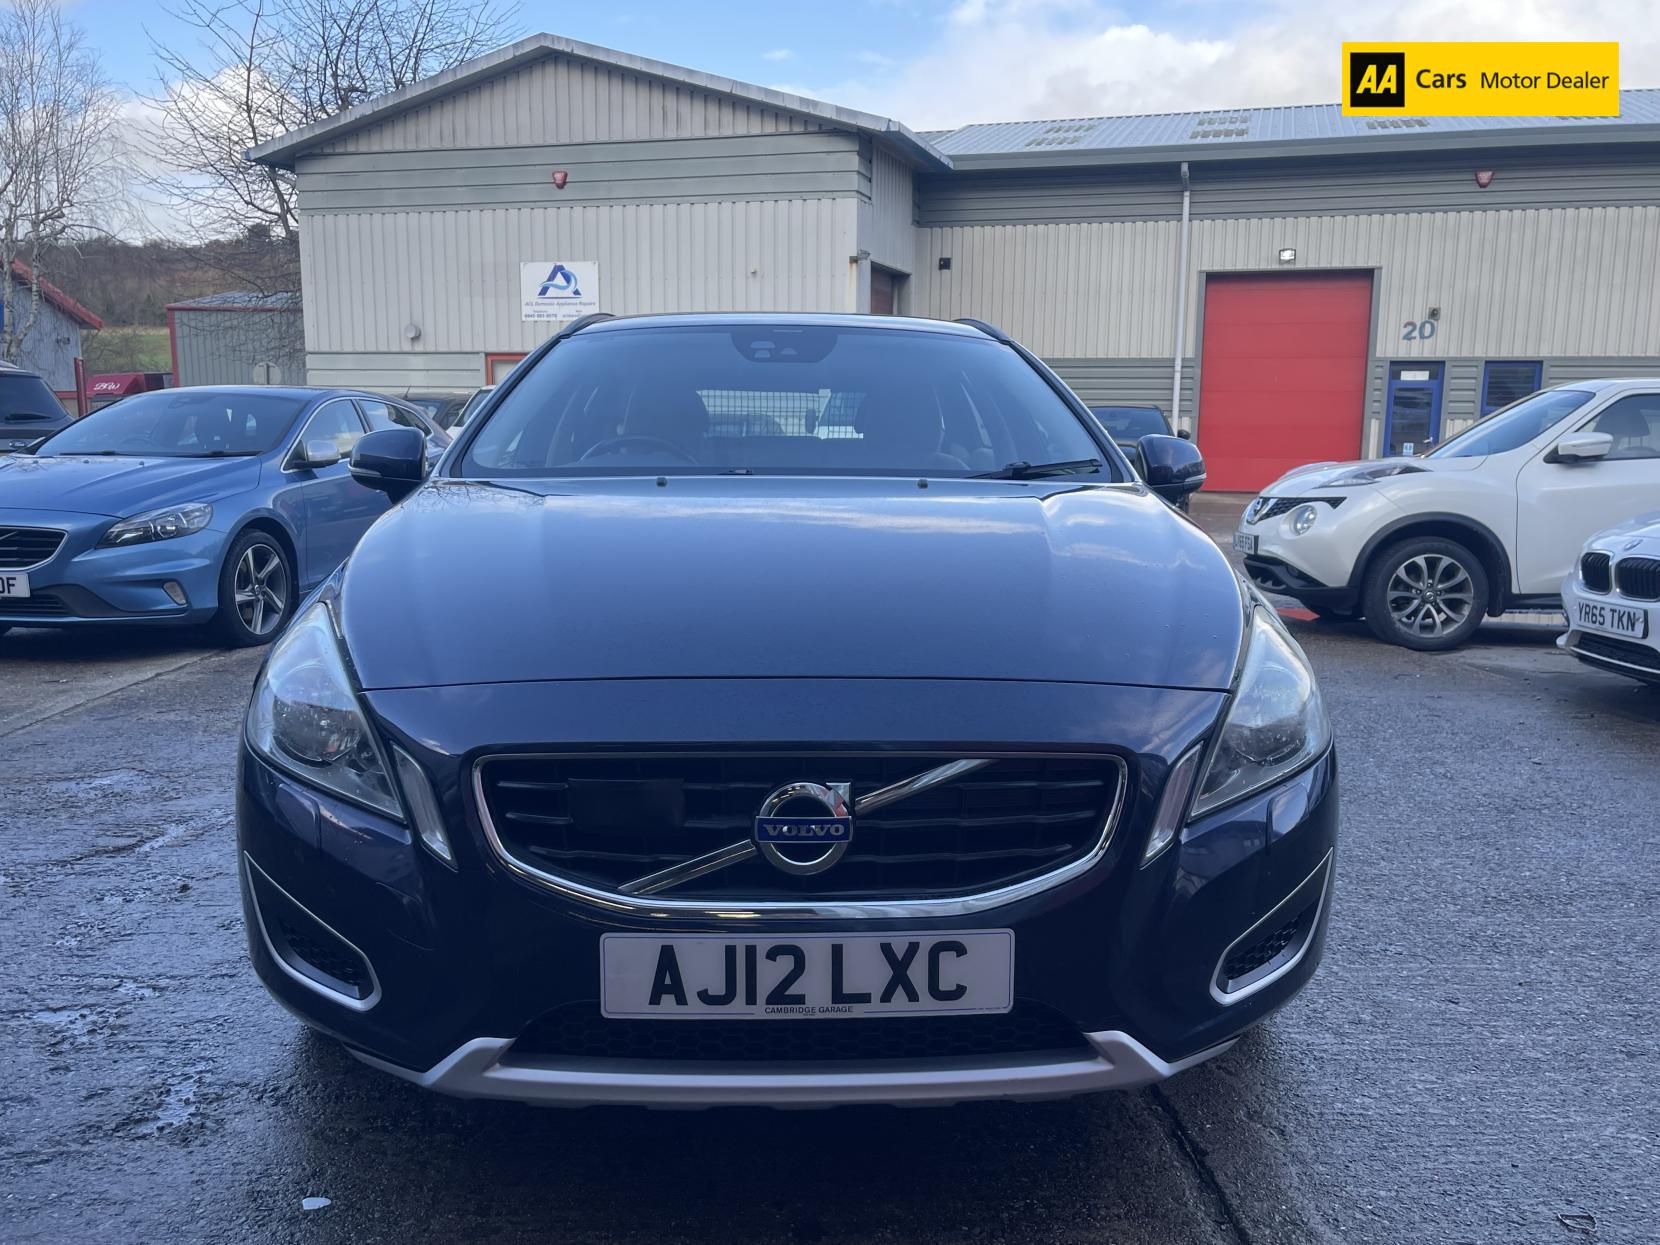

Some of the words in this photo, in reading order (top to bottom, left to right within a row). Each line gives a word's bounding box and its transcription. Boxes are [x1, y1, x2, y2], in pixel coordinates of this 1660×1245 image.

[1402, 320, 1436, 341] 20
[1578, 602, 1606, 626] YR65
[1609, 608, 1636, 632] TKN
[763, 824, 845, 837] VOLVO
[648, 944, 807, 1006] AJ12
[831, 940, 968, 1005] LXC
[764, 1006, 817, 1014] CAMBRIDGE
[818, 1005, 854, 1013] GARAGE
